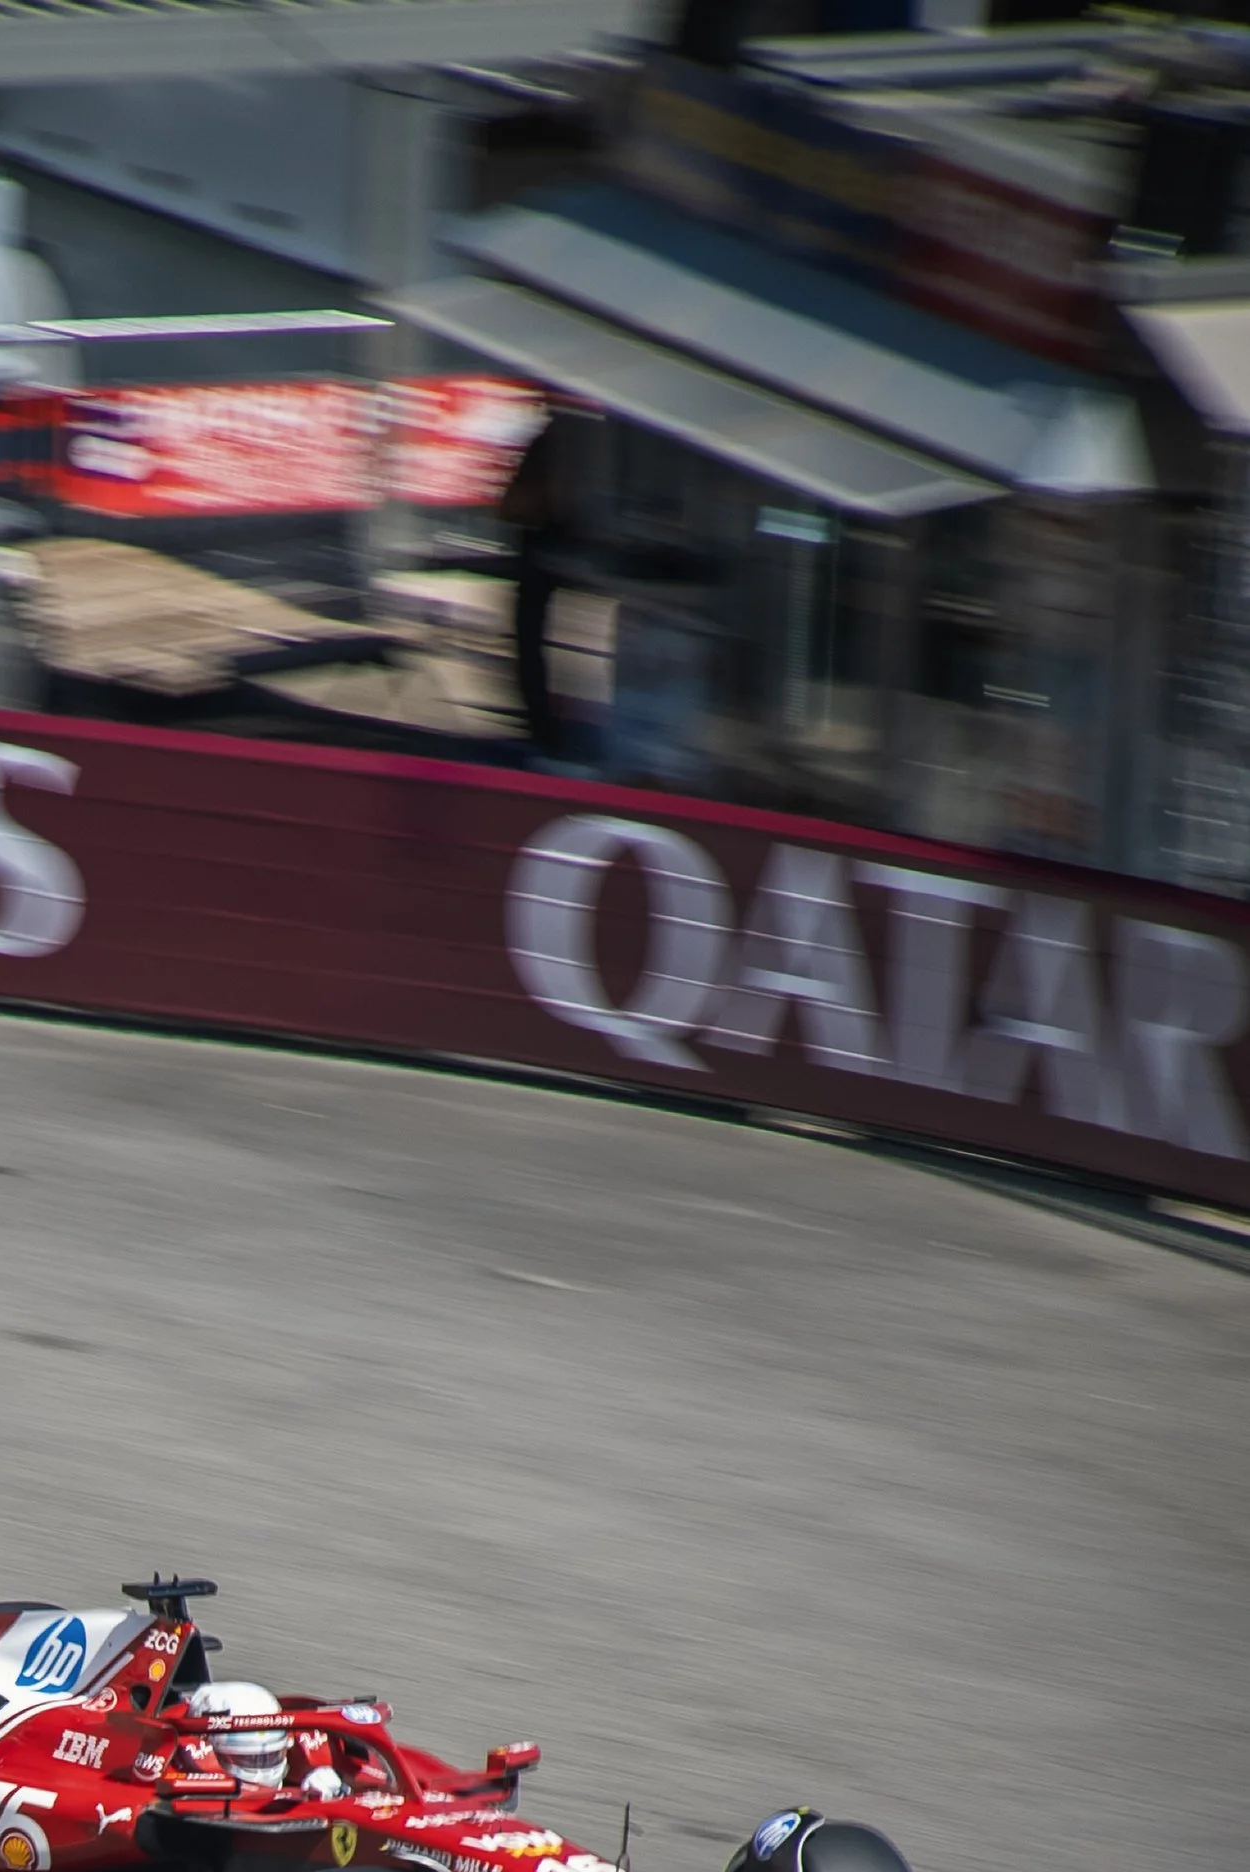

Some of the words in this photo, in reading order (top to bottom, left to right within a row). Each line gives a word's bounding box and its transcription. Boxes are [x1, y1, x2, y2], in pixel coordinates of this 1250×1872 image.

[505, 815, 1250, 1160] QATAR
[21, 1614, 84, 1693] hp
[207, 1715, 232, 1730] DXC
[234, 1715, 296, 1728] TECHNOLOGY
[52, 1729, 110, 1769] IBM
[134, 1751, 166, 1774] aws
